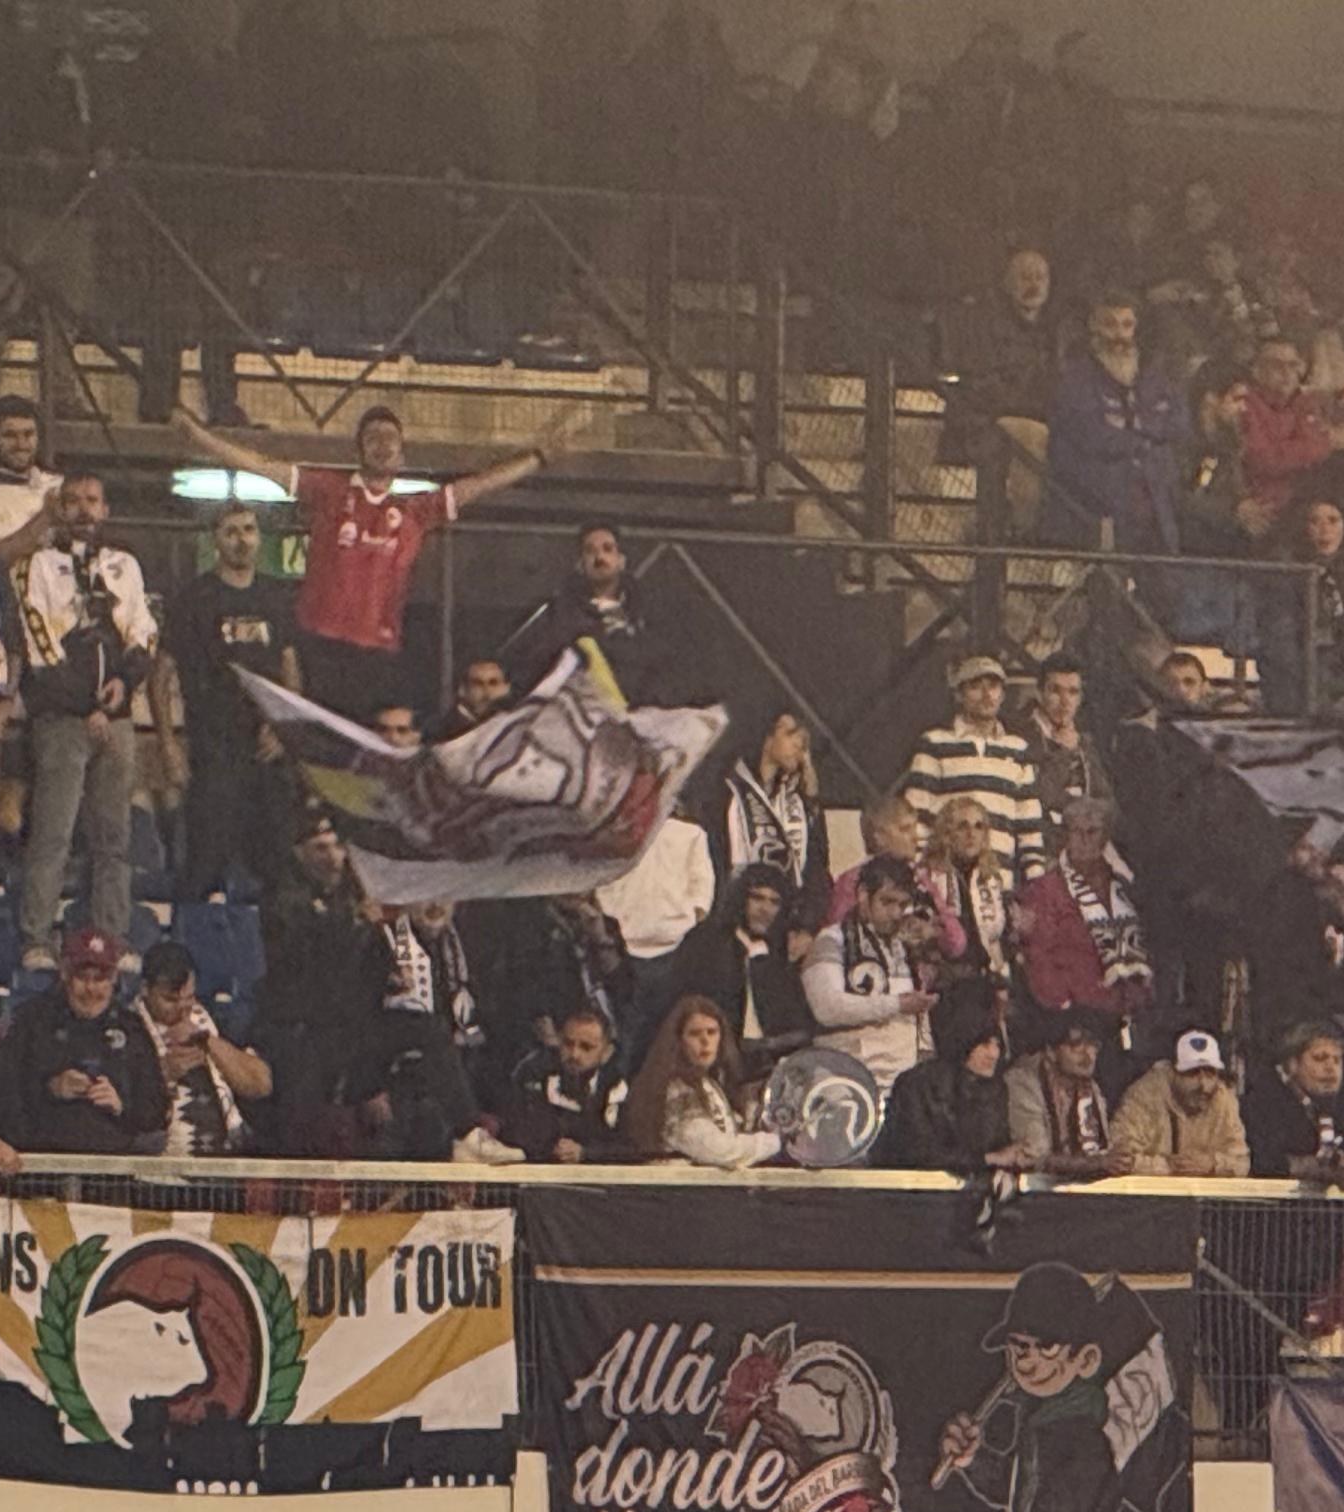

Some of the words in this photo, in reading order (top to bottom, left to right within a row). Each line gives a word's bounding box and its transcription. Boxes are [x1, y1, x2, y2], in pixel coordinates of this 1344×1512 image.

[306, 1247, 367, 1318] ON
[392, 1242, 504, 1314] TOUR
[565, 1323, 723, 1418] Allá
[573, 1419, 796, 1509] donde
